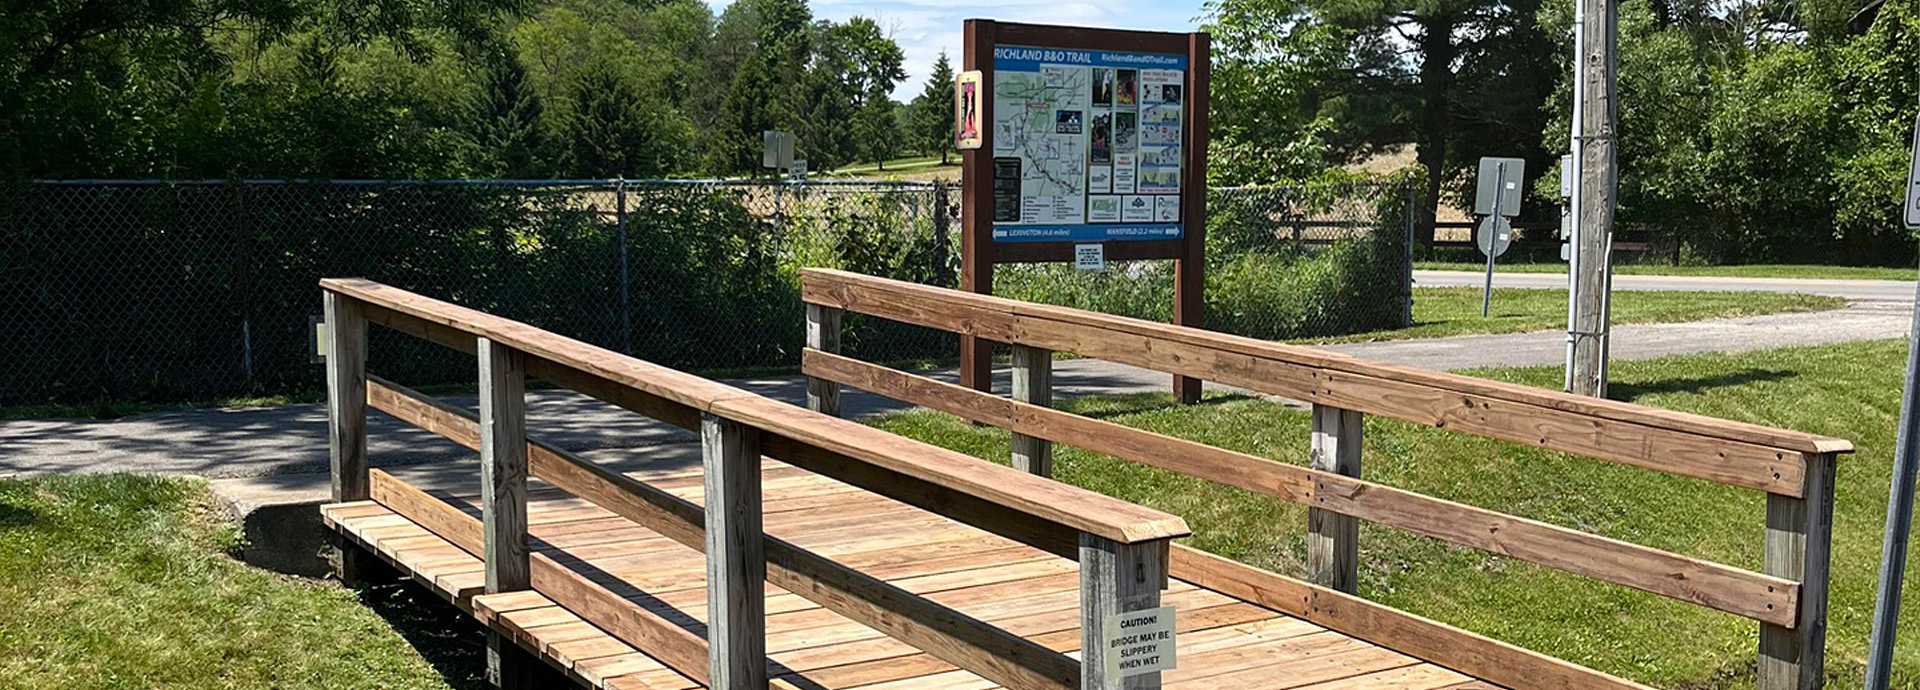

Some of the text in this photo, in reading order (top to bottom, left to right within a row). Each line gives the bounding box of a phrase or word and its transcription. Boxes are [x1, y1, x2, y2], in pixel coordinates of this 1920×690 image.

[994, 48, 1091, 63] RICHLAND B&O TRAIL
[1054, 228, 1071, 237] miles)
[1121, 616, 1157, 629] CAUTION!
[1111, 631, 1170, 648] BRIDGE MAY BE
[1121, 644, 1157, 658] SLIPPERY
[1119, 656, 1160, 670] WHEN WET
